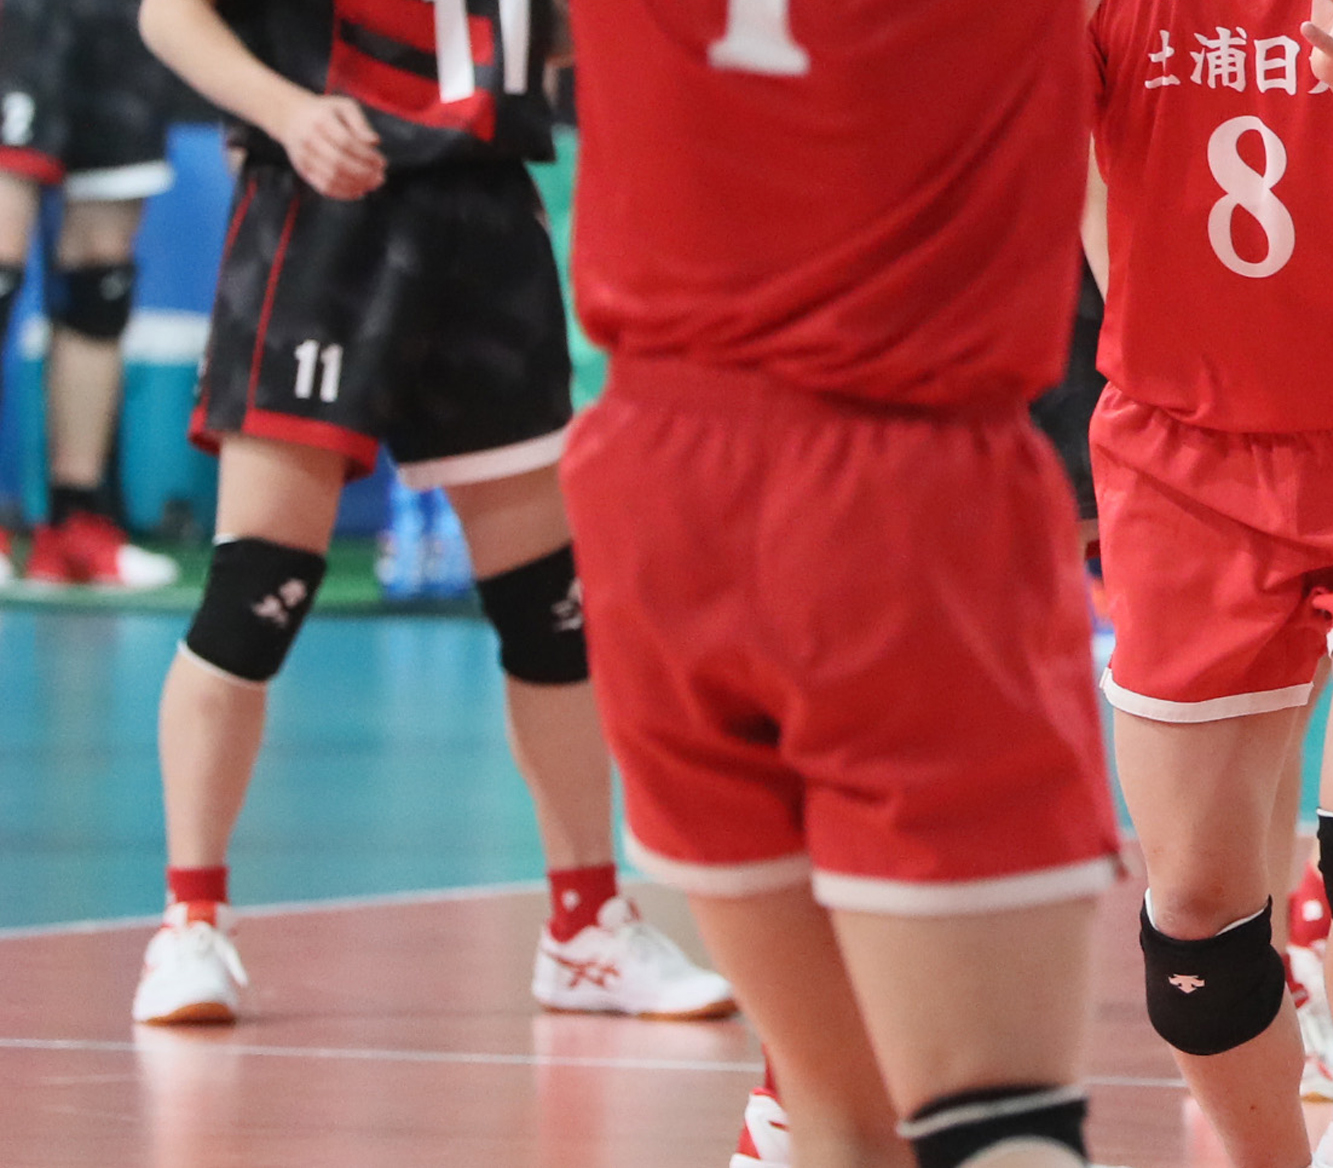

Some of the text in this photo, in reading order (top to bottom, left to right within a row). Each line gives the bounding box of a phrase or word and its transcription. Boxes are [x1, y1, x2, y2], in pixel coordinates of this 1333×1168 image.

[1145, 26, 1330, 96] 土浦日
[1207, 115, 1296, 278] 8
[294, 339, 343, 403] 11
